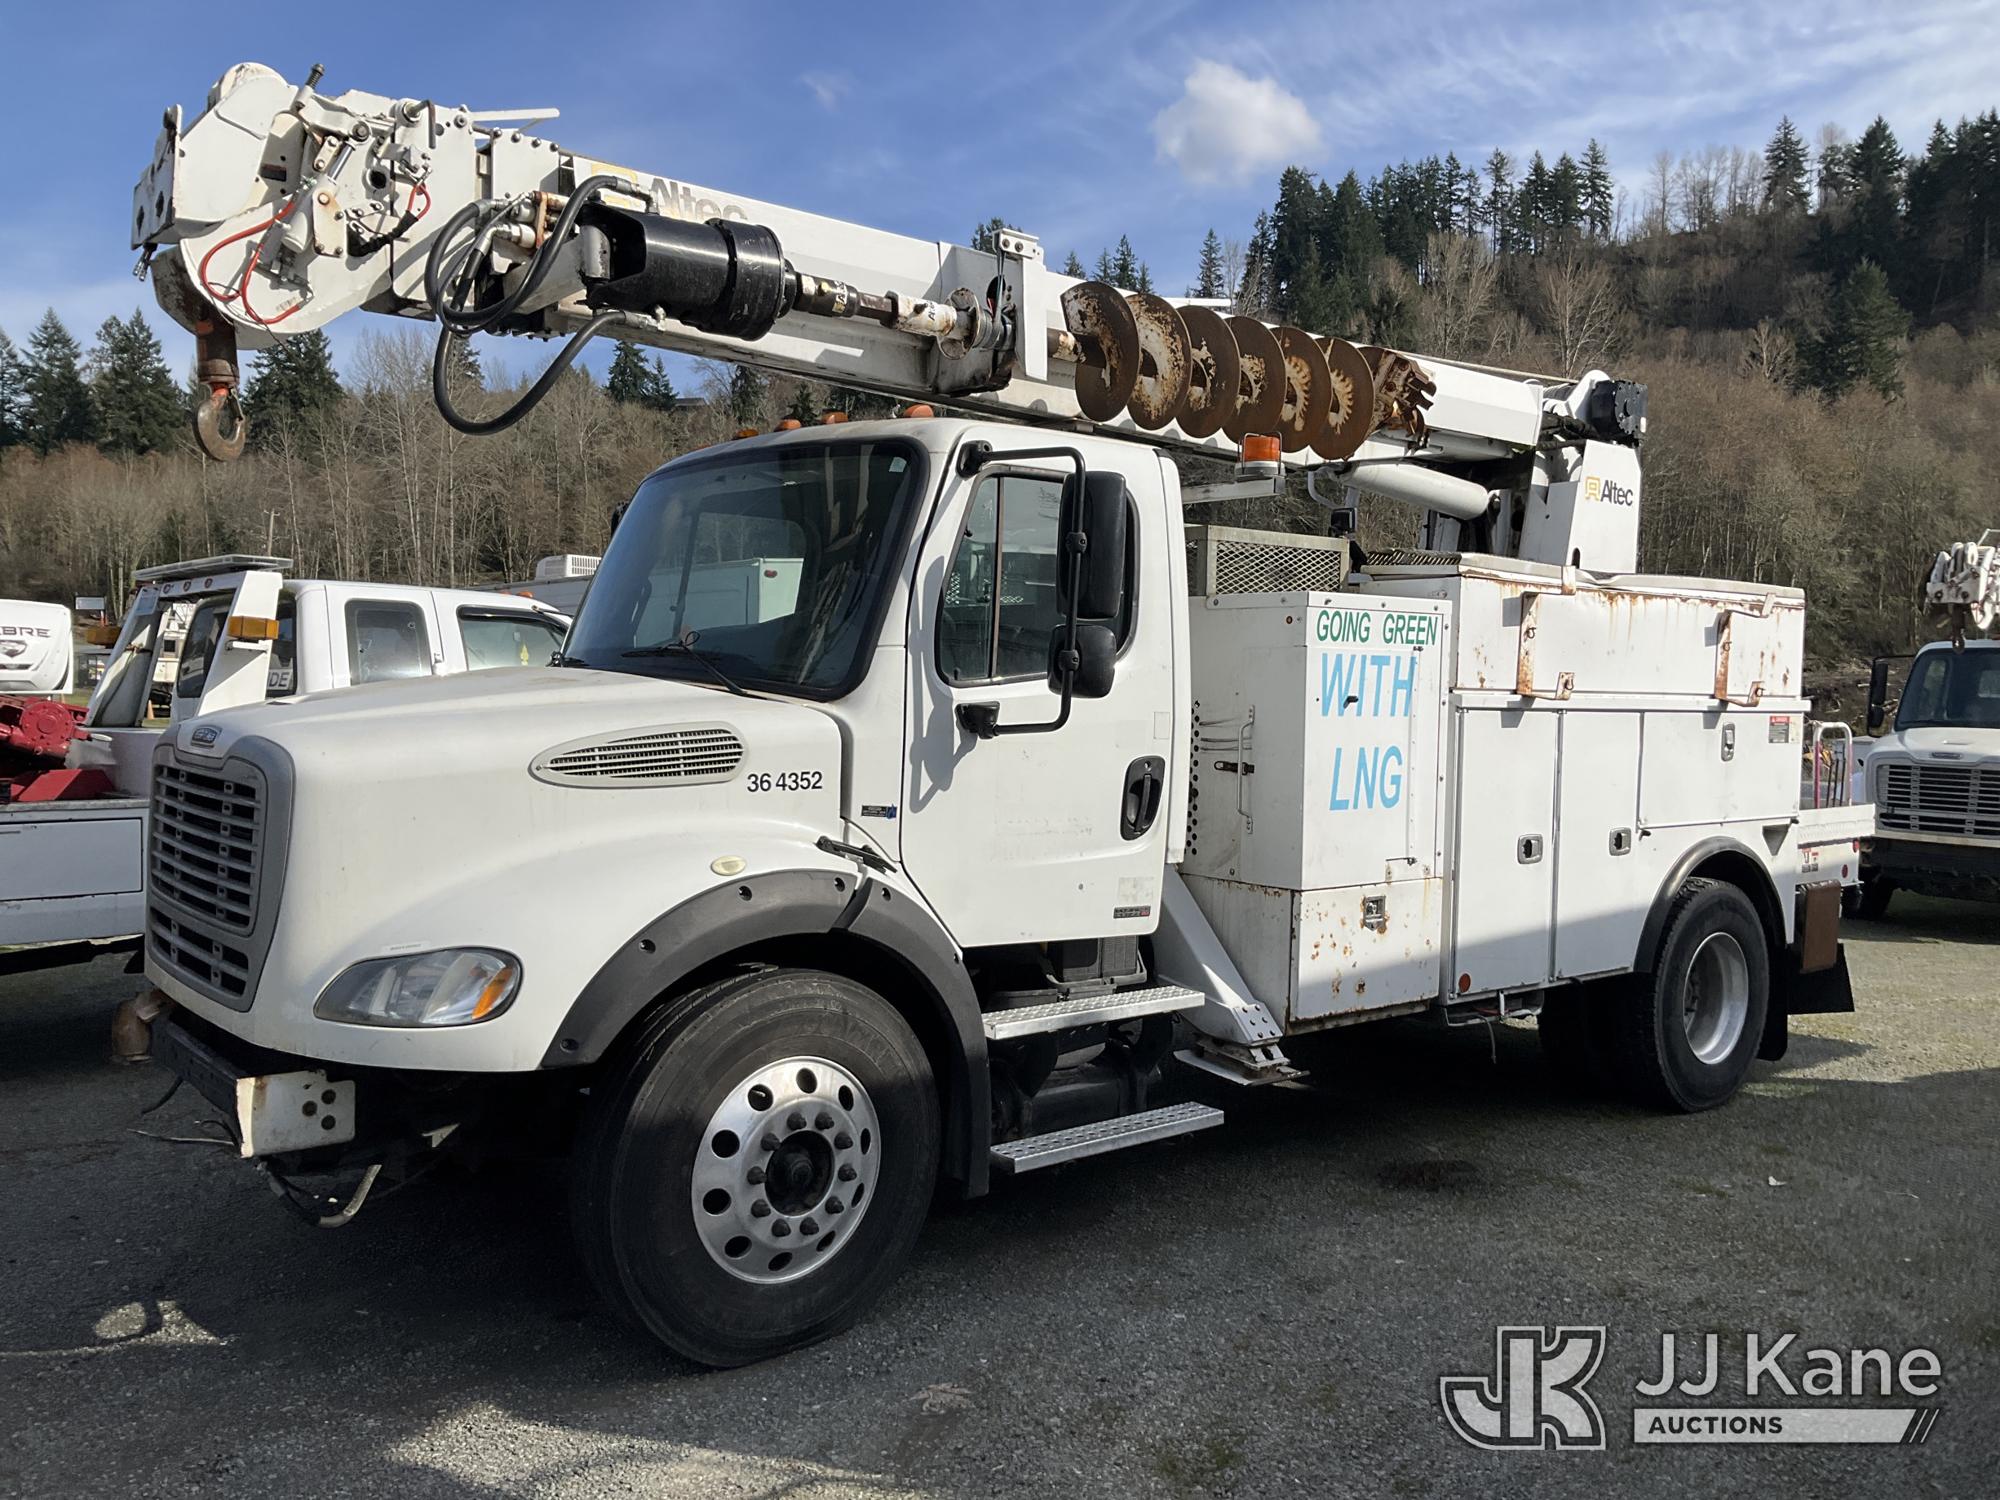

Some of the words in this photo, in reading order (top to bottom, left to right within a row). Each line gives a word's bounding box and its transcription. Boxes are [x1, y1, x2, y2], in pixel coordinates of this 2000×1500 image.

[1600, 479, 1633, 506] Altec
[0, 626, 51, 638] BRE
[1316, 609, 1371, 644] GOING
[1382, 613, 1438, 646] GREEN
[1321, 652, 1417, 717] WITH
[747, 773, 772, 793] 36
[775, 770, 823, 791] 4352
[1329, 745, 1403, 811] LNG
